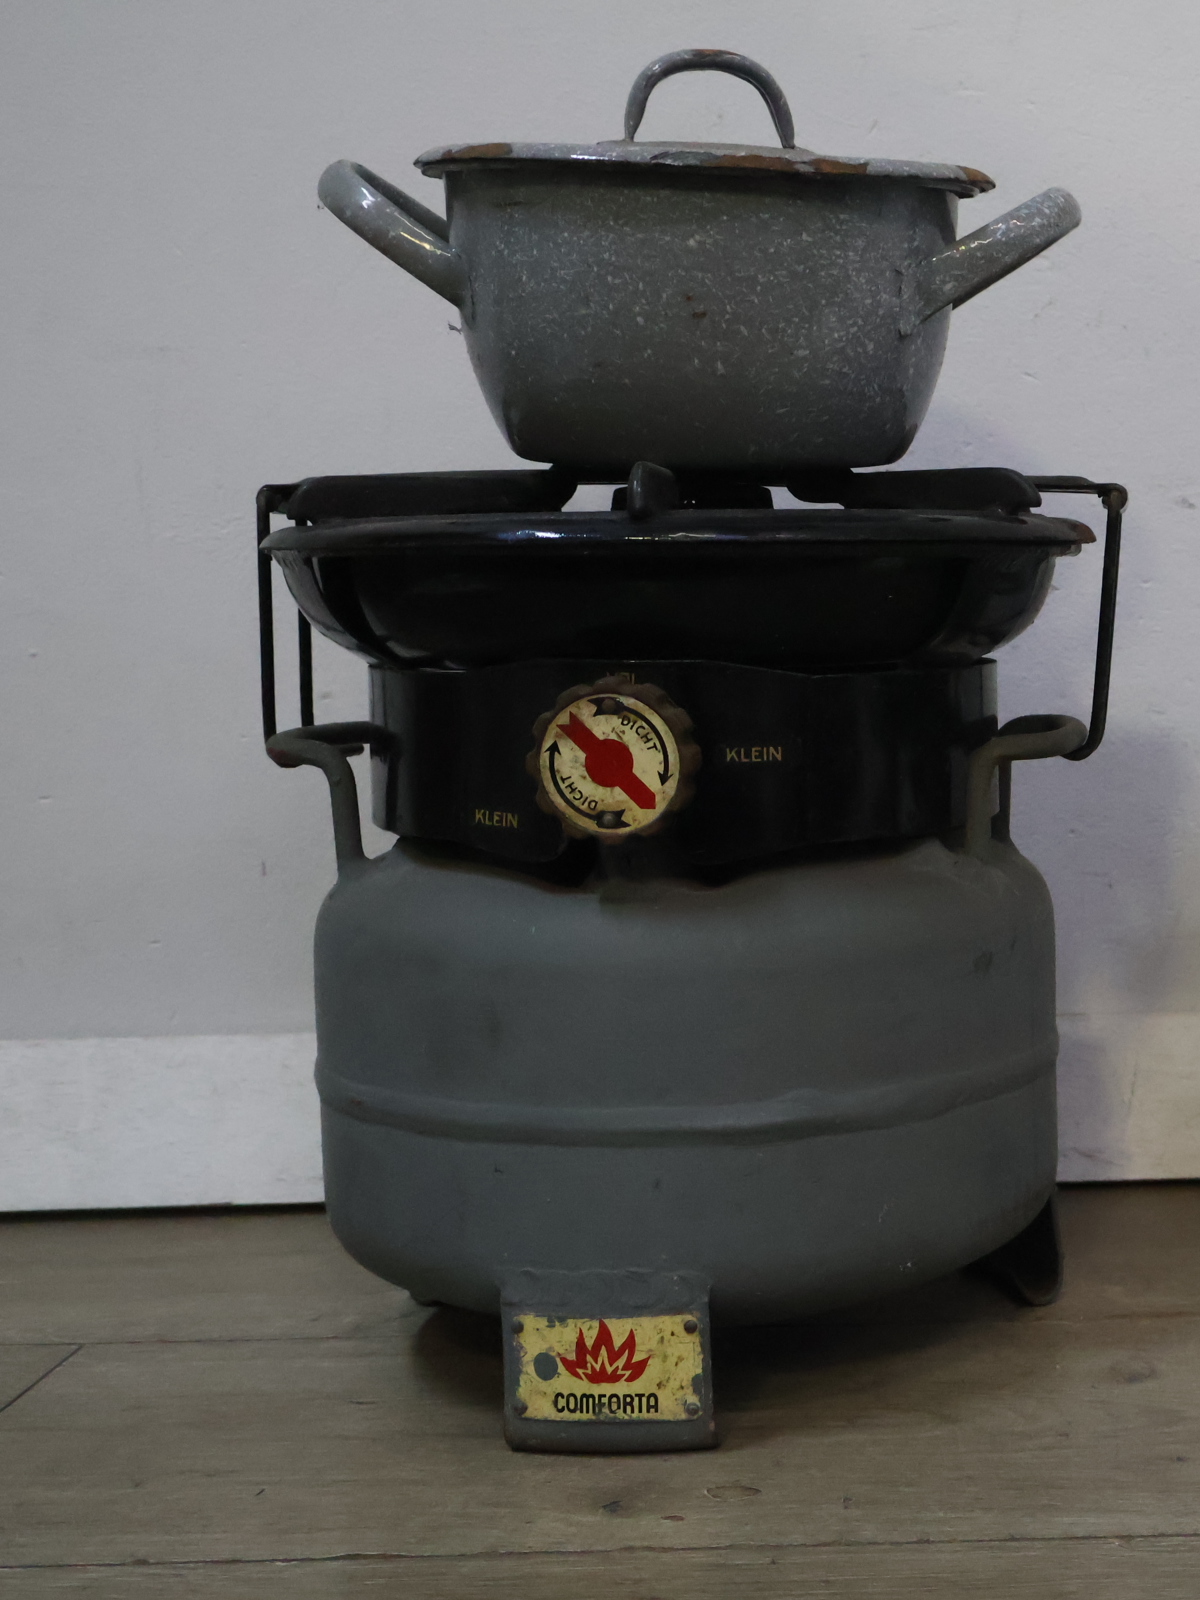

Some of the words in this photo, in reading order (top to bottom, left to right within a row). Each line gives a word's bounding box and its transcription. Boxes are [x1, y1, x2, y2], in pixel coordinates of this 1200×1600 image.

[620, 715, 659, 753] DICHT
[726, 746, 782, 762] KLEIN
[560, 775, 599, 812] DICHT
[475, 808, 518, 829] KLEIN
[553, 1392, 659, 1414] COMFORTA
